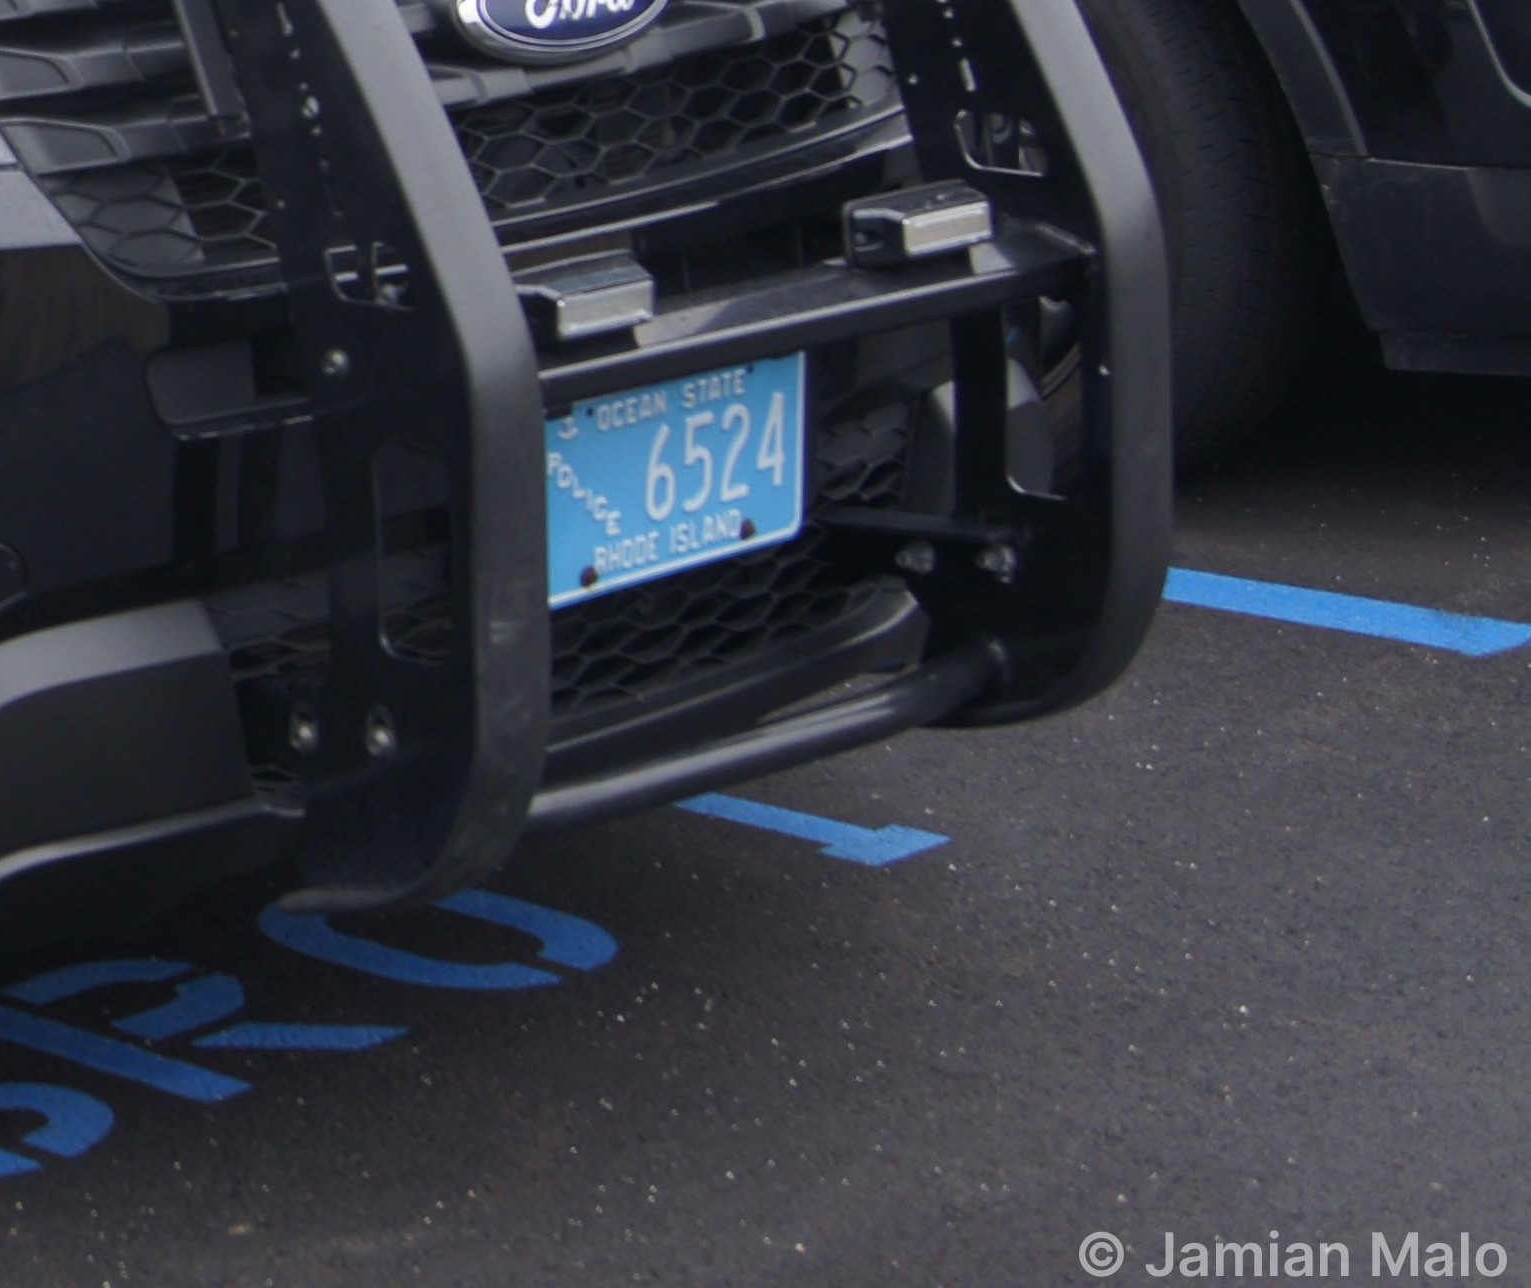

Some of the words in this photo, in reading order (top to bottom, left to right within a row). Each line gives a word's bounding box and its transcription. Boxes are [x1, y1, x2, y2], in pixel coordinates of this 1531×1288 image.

[596, 390, 668, 432] OCEAN
[681, 368, 746, 409] STATE
[645, 392, 786, 521] 6524
[593, 530, 661, 574] RHODE
[669, 508, 743, 555] ISLAND
